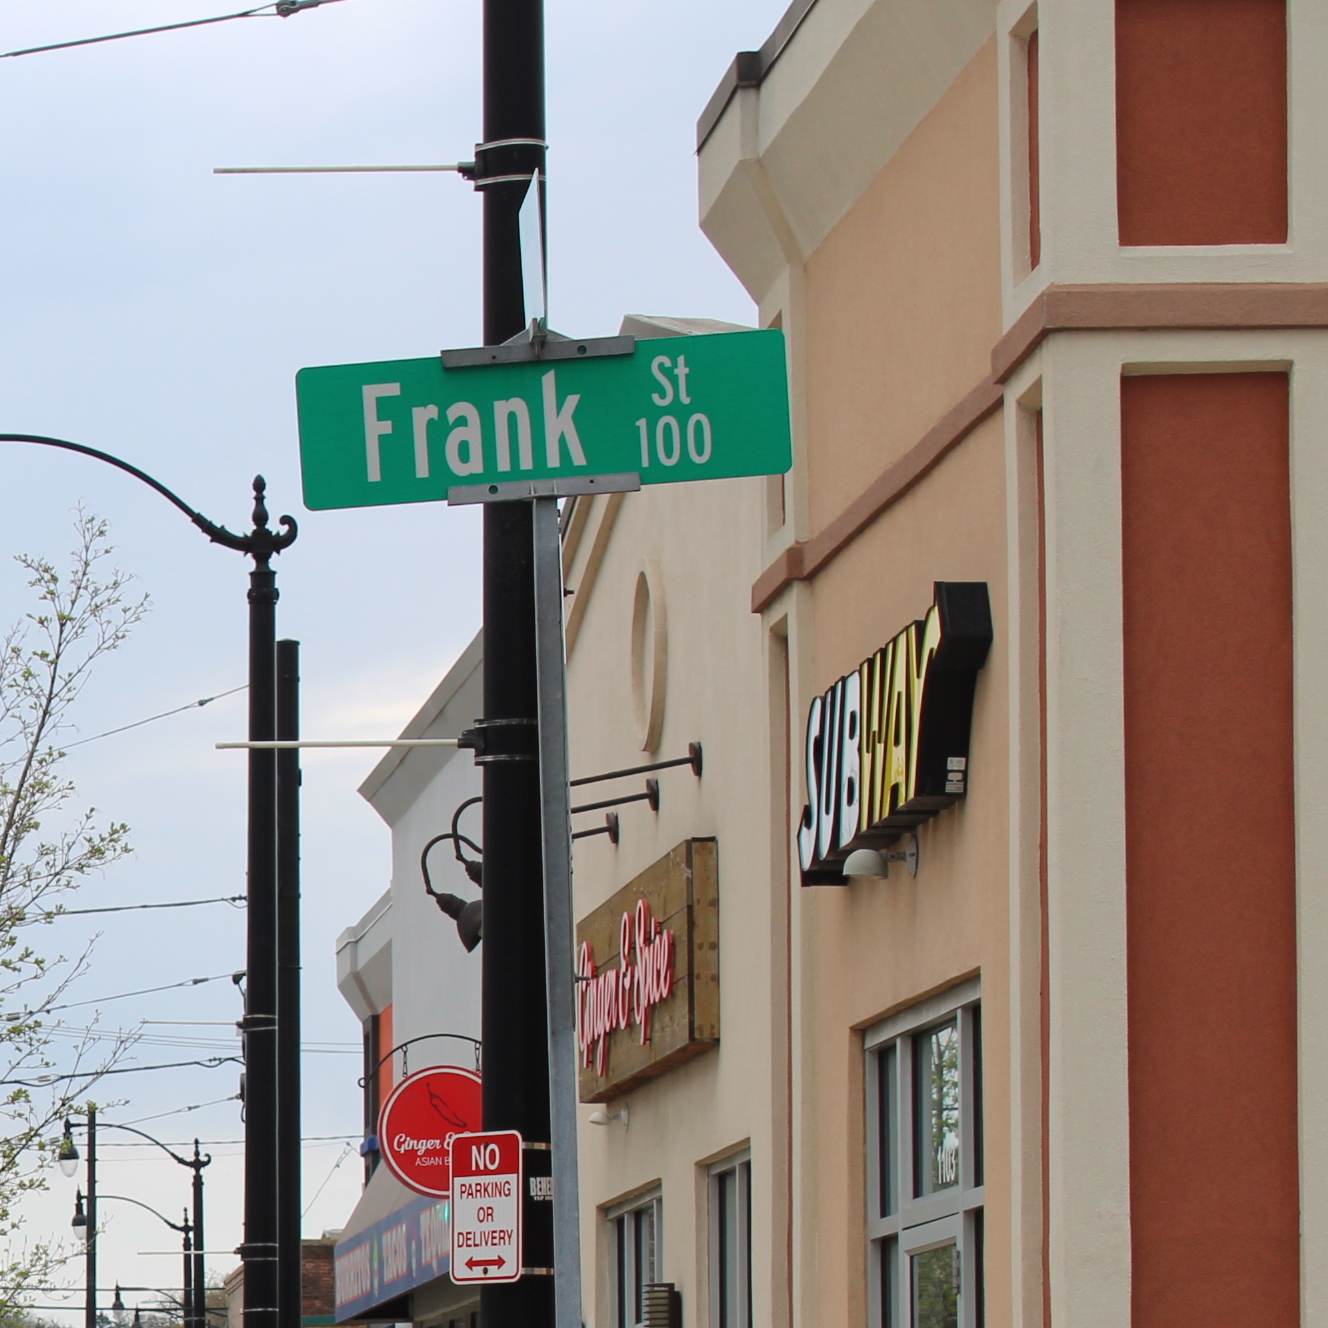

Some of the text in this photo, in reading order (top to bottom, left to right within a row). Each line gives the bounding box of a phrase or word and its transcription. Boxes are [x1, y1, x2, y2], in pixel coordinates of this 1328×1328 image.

[361, 353, 692, 483] Frank St
[634, 412, 713, 469] 100
[797, 603, 942, 872] SUBWAY
[577, 898, 674, 1078] Ginger & Spice
[393, 1133, 442, 1156] Ginger
[471, 1143, 500, 1171] NO
[415, 1157, 443, 1167] ASIAN
[460, 1181, 512, 1200] PARKING
[477, 1206, 494, 1223] OR
[457, 1229, 514, 1248] DELIVERY
